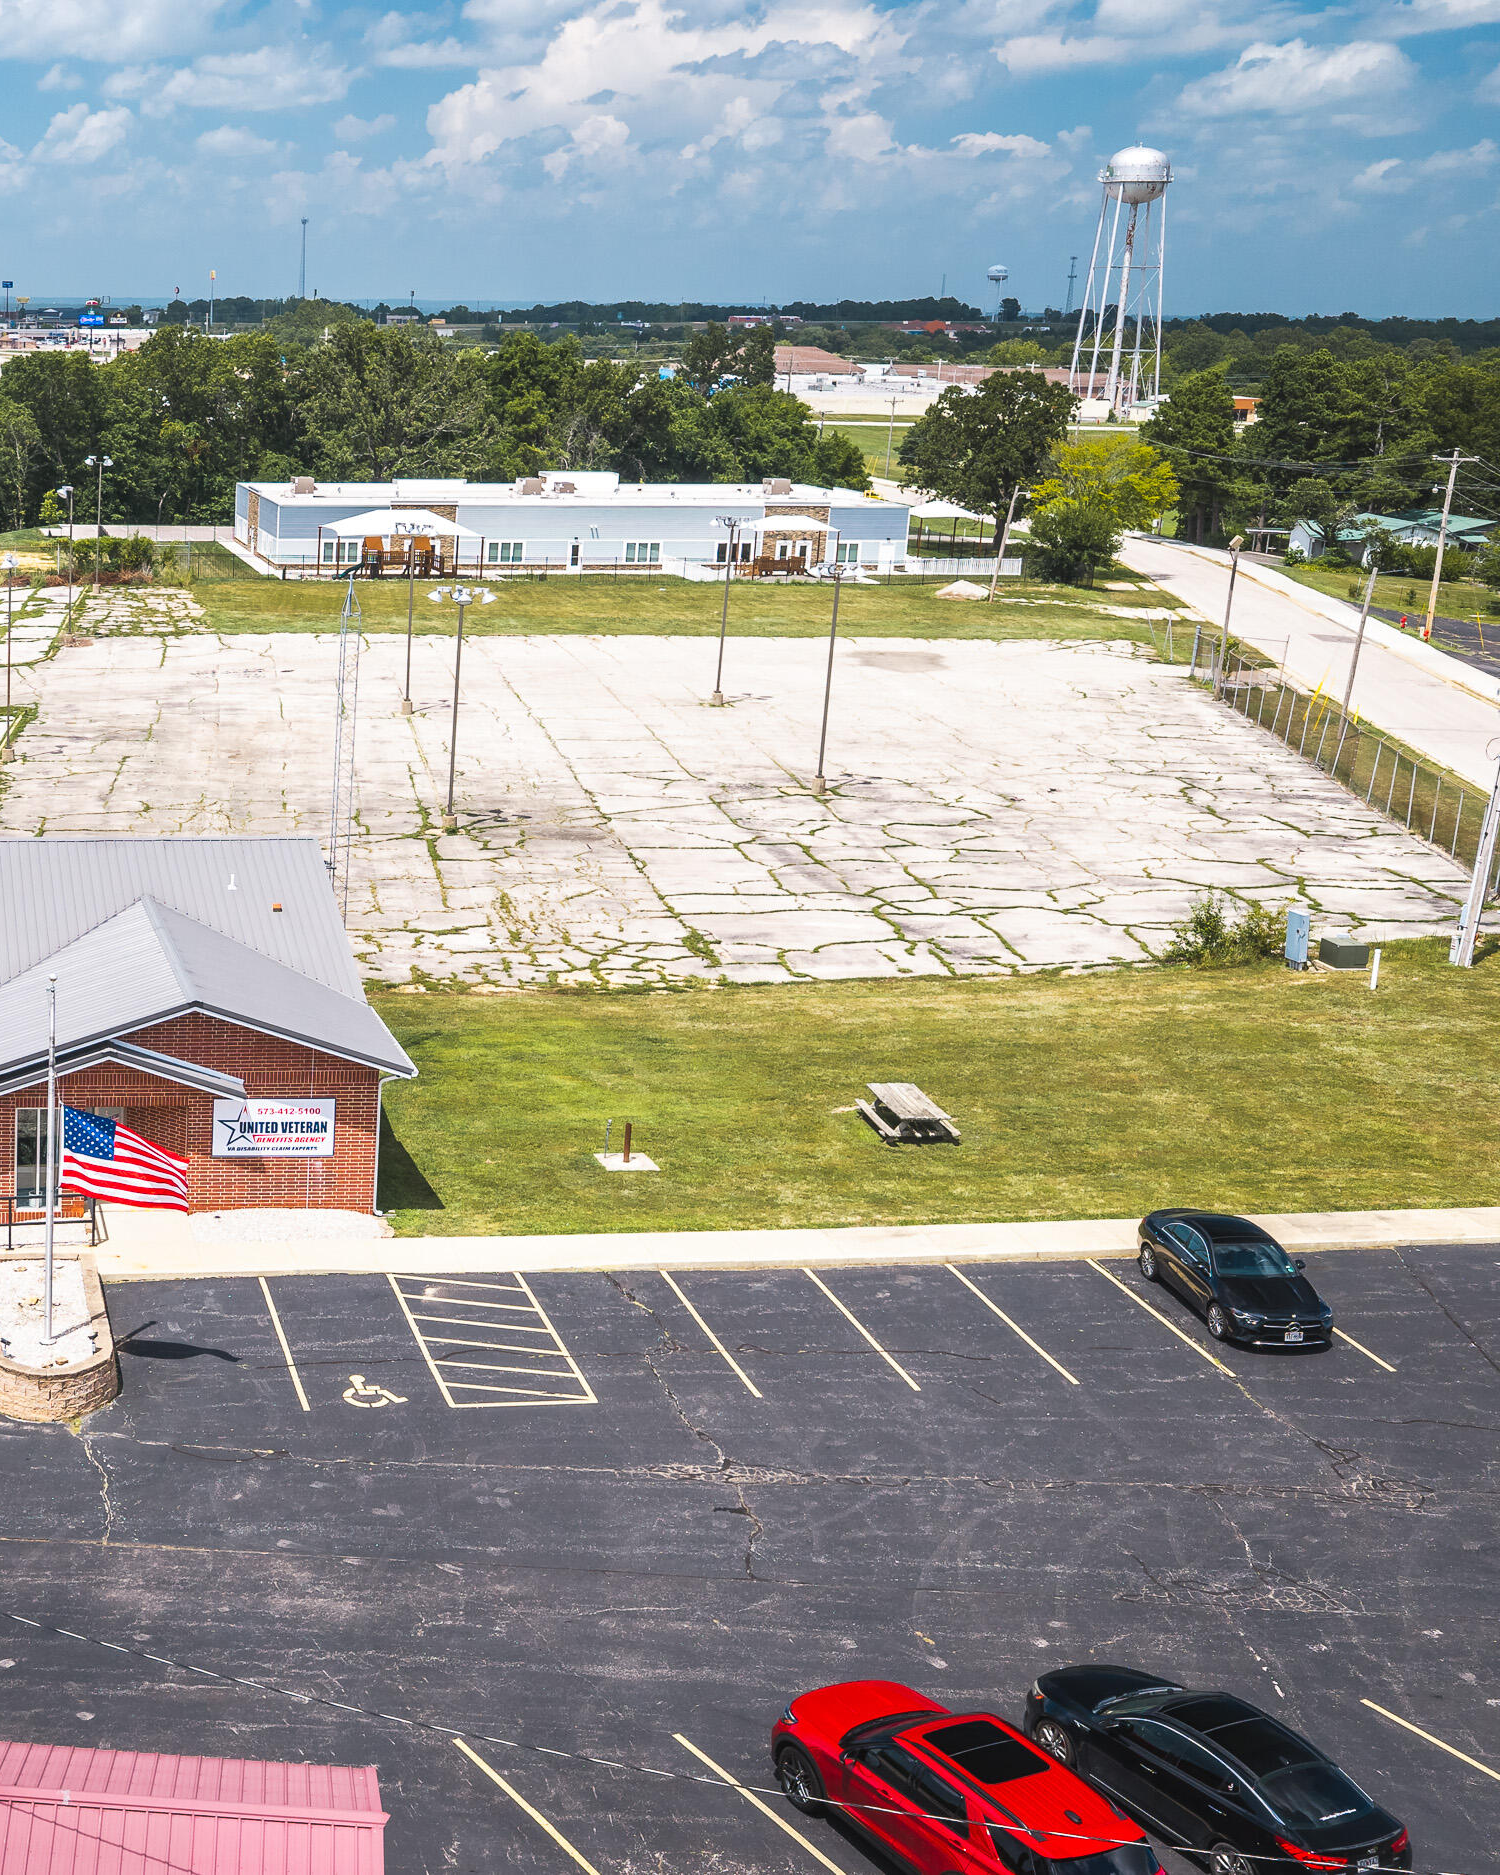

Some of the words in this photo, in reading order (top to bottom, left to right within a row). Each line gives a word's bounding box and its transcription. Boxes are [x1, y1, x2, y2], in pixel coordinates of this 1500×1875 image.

[257, 1107, 321, 1115] 573-412-5100
[240, 1121, 278, 1134] UNITED
[280, 1121, 328, 1134] VETERAN
